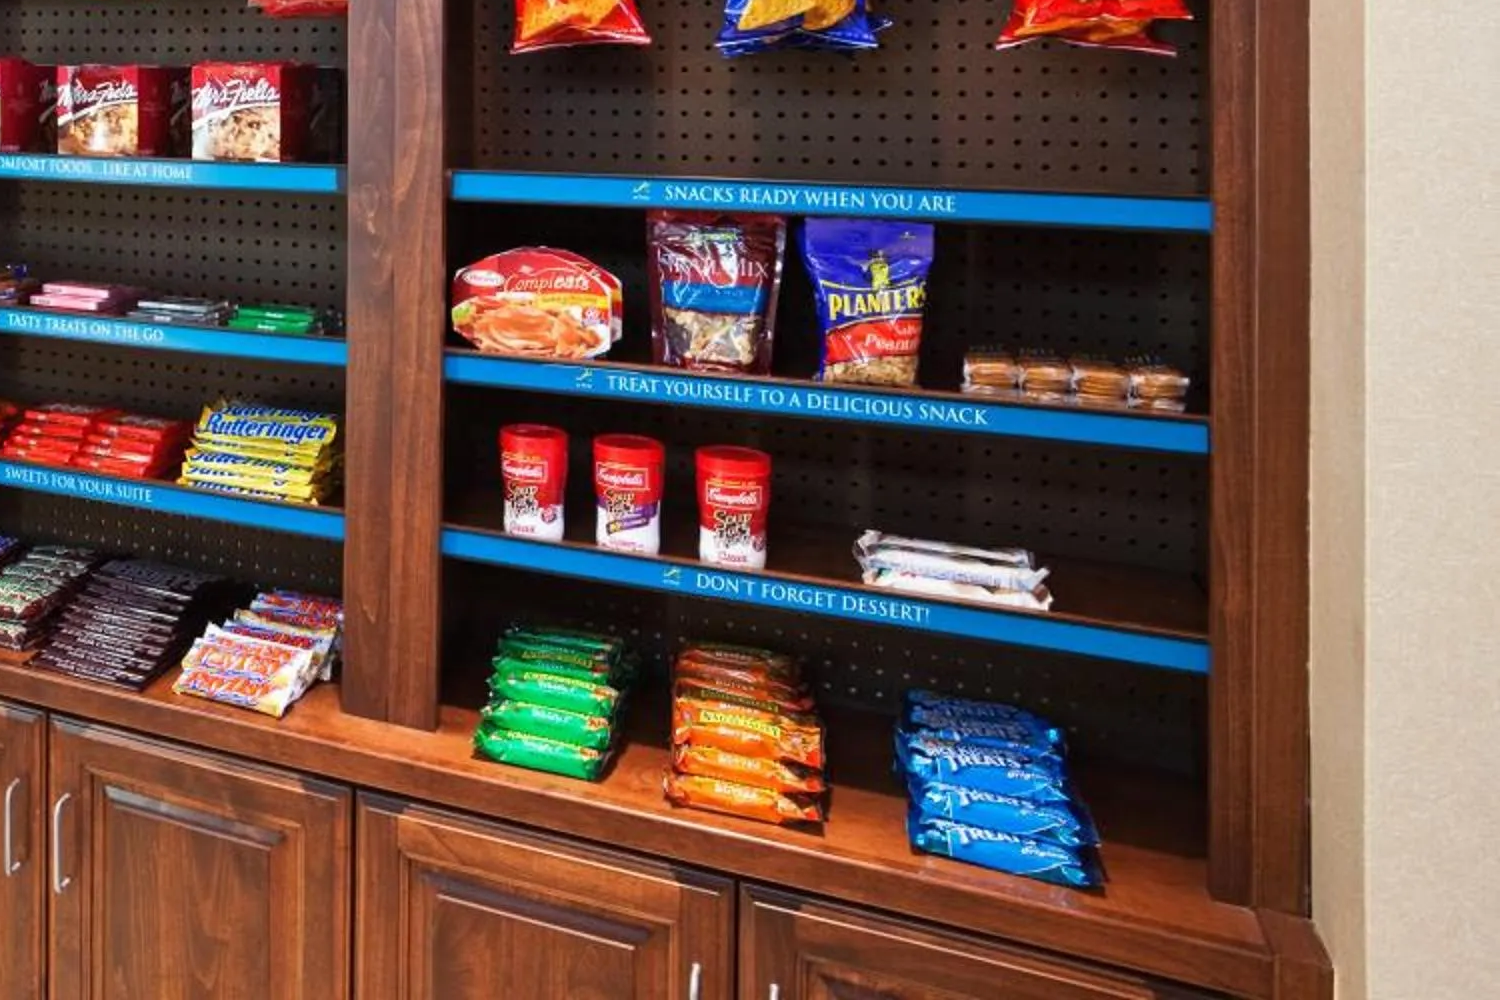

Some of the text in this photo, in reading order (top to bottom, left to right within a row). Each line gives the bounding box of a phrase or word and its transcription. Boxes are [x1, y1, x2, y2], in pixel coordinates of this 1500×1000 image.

[152, 163, 193, 180] HOME
[664, 183, 957, 213] SNACKS READY WHEN YOU ARE
[7, 312, 41, 329] TASTY
[45, 316, 88, 335] TREATS
[89, 320, 111, 336] ON
[142, 327, 165, 343] GO
[607, 375, 989, 426] TREAT YOURSELF TO A DELICIOUS SNACK
[206, 412, 329, 444] Butterfinger
[4, 465, 153, 503] SWEETS FOR YOUR SUITE
[696, 572, 931, 624] DON'T FORGET DESSERT!
